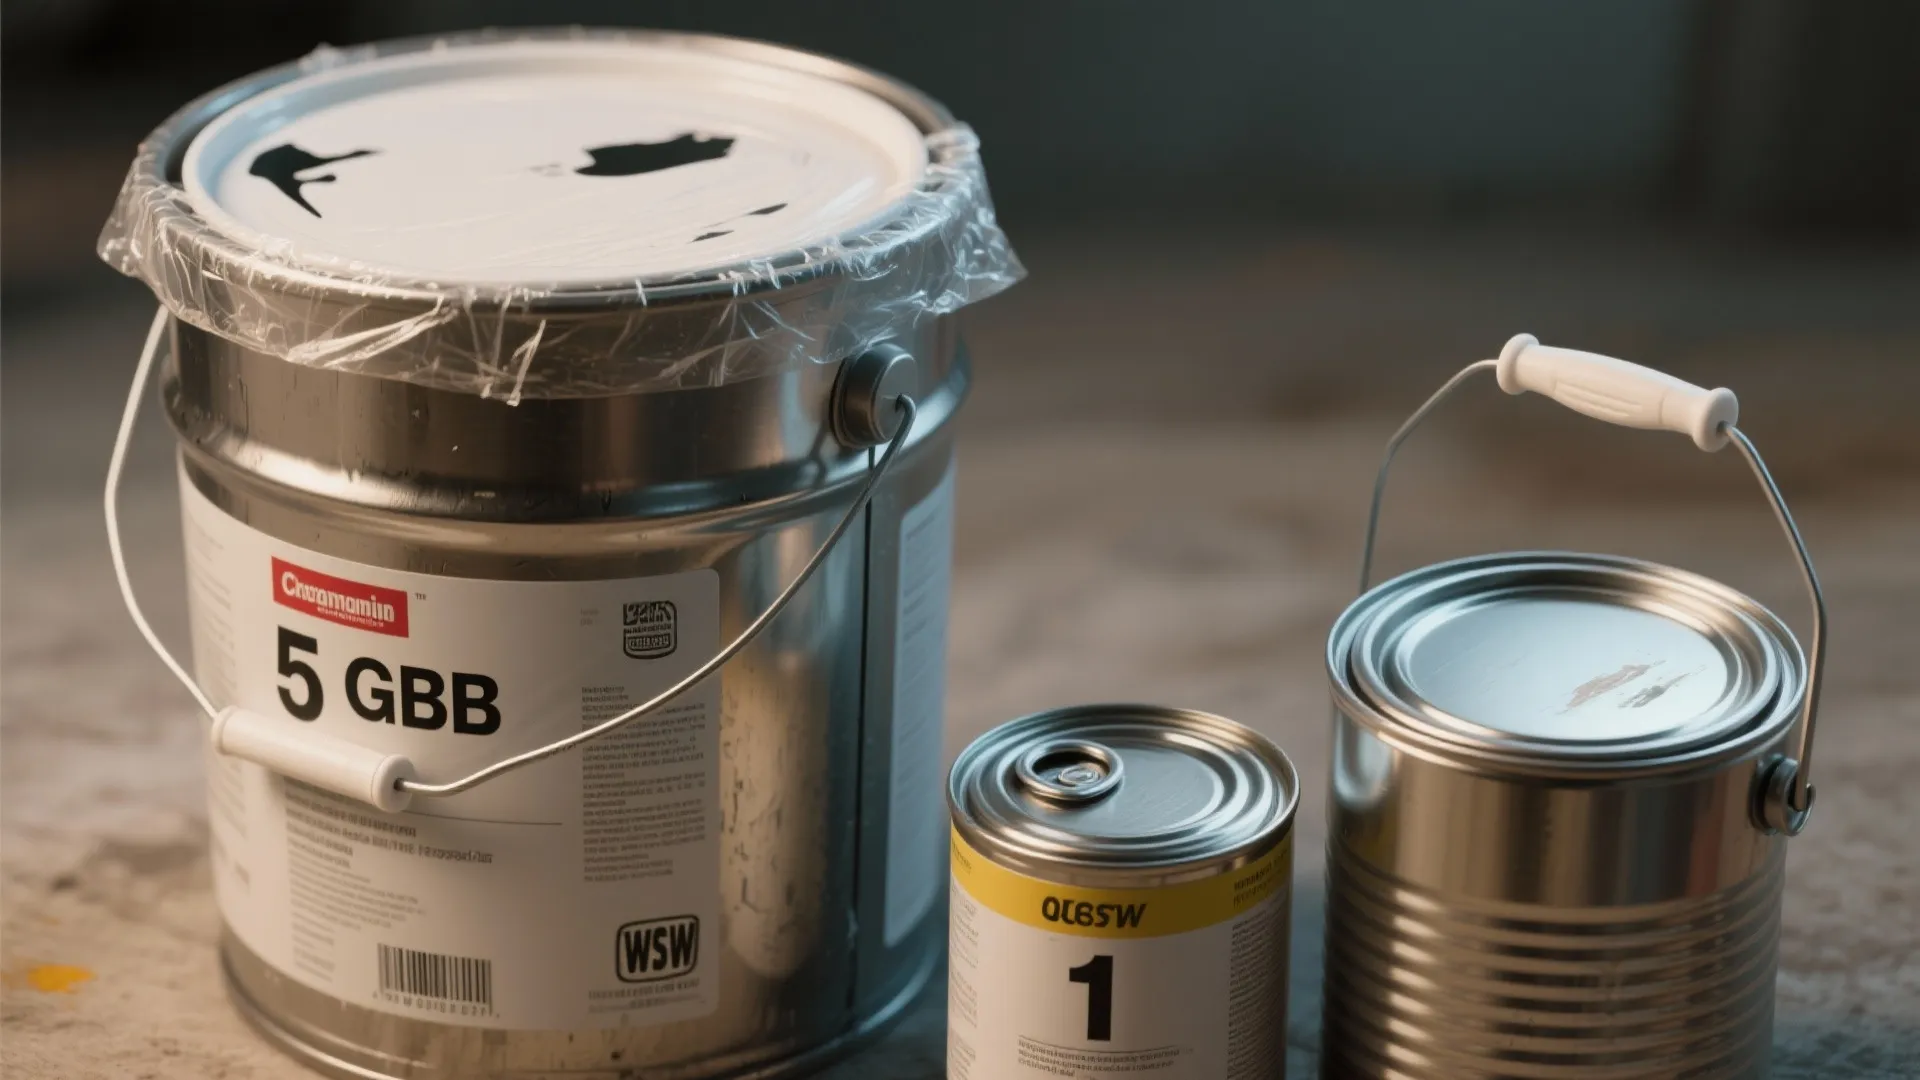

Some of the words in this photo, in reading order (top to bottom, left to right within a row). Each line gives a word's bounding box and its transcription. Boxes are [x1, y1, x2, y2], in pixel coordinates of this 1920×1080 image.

[277, 624, 324, 722] 5
[345, 657, 501, 736] GBB
[624, 921, 695, 974] WSW
[1069, 955, 1113, 1041] 1
